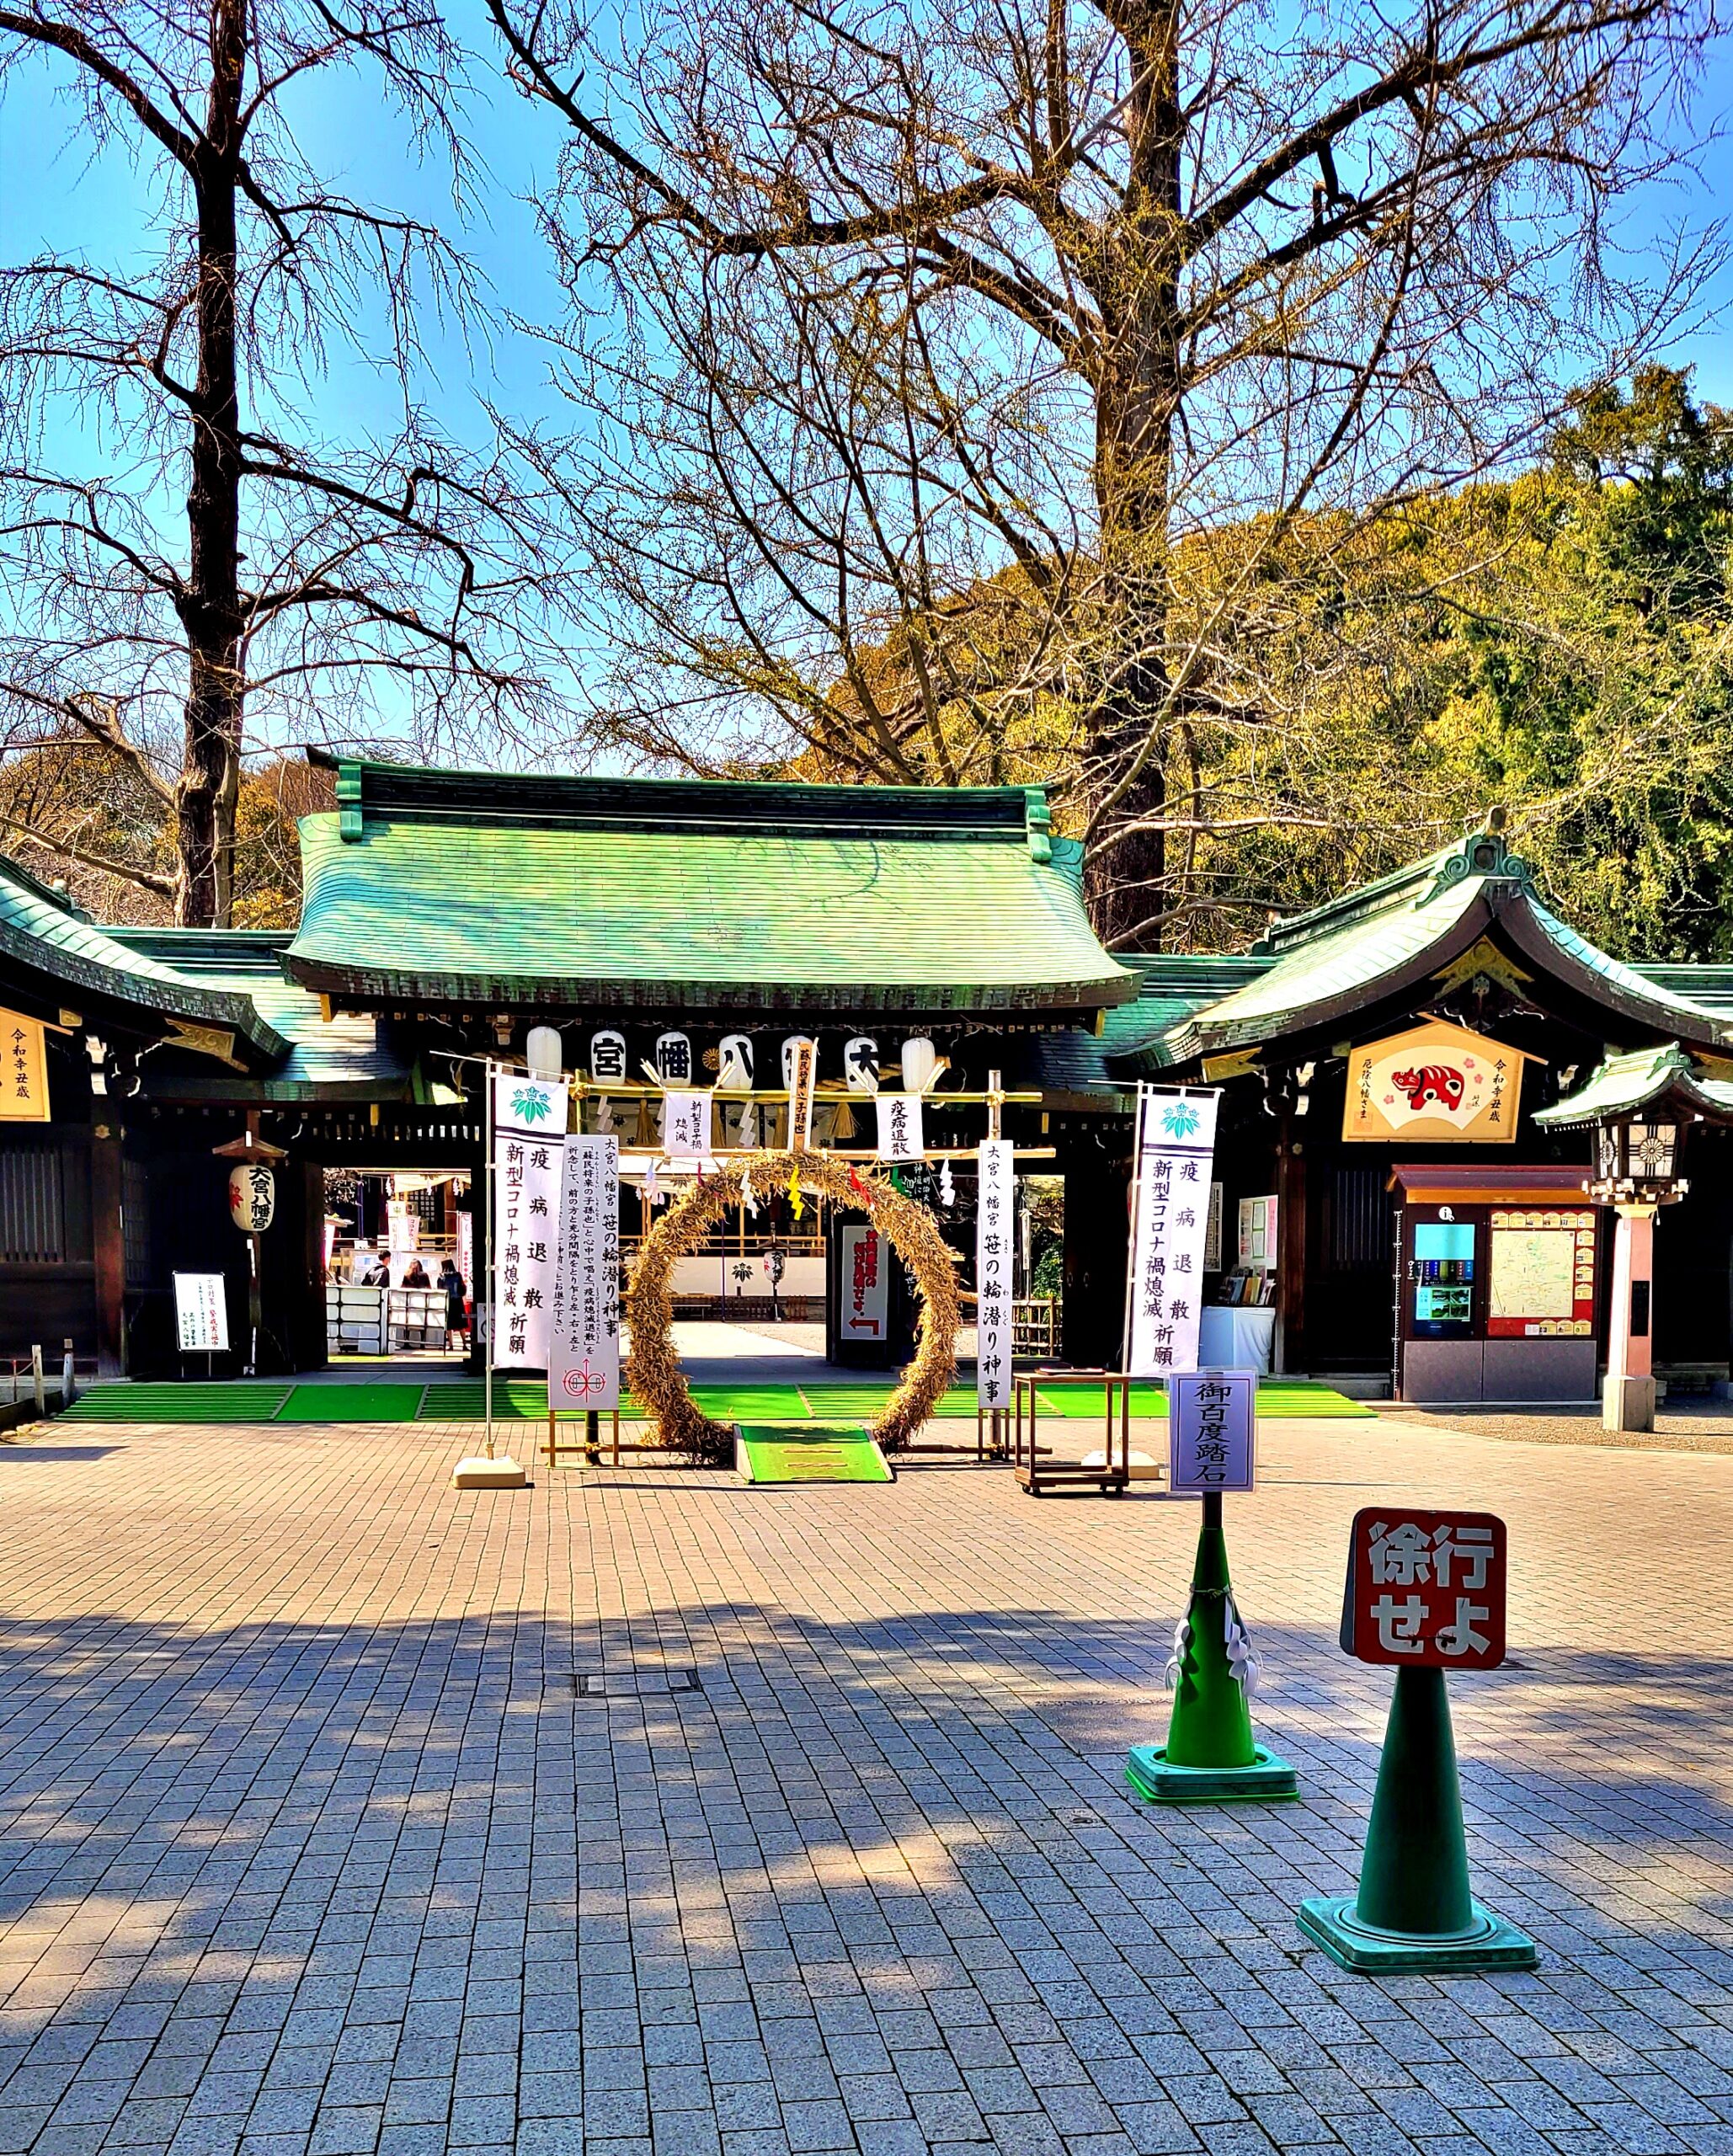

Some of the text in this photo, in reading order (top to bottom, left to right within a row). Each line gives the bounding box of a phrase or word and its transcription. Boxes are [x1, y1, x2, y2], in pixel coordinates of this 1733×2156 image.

[11, 1028, 30, 1098] 令和辛丑歳
[593, 1038, 625, 1076] 宮
[659, 1040, 690, 1079] 幡
[723, 1042, 754, 1079] 八
[849, 1044, 879, 1084] 大
[1360, 1059, 1372, 1118] 厄除八幡さま
[1489, 1059, 1506, 1123] 令和辛丑歳
[690, 1100, 703, 1150] 新型コロナ禍
[890, 1100, 911, 1155] 疫病退散
[249, 1167, 271, 1229] 大宮八幡宮
[504, 1143, 525, 1307] 新型コロナ禍熄滅
[523, 1148, 552, 1308] 疫病退散
[602, 1139, 619, 1337] 大宮八幡宮 笹の輪潜り神事
[1143, 1159, 1173, 1319] 新型コロナ禍熄滅
[1169, 1161, 1200, 1320] 疫病退散
[982, 1145, 1001, 1402] 大宮八幡宮 笹の輪潜り神事
[509, 1312, 528, 1354] 祈願
[1153, 1323, 1175, 1366] 祈願
[1192, 1382, 1232, 1482] 御百度踏石
[1368, 1521, 1495, 1589] 徐行
[1370, 1594, 1491, 1656] せよ
